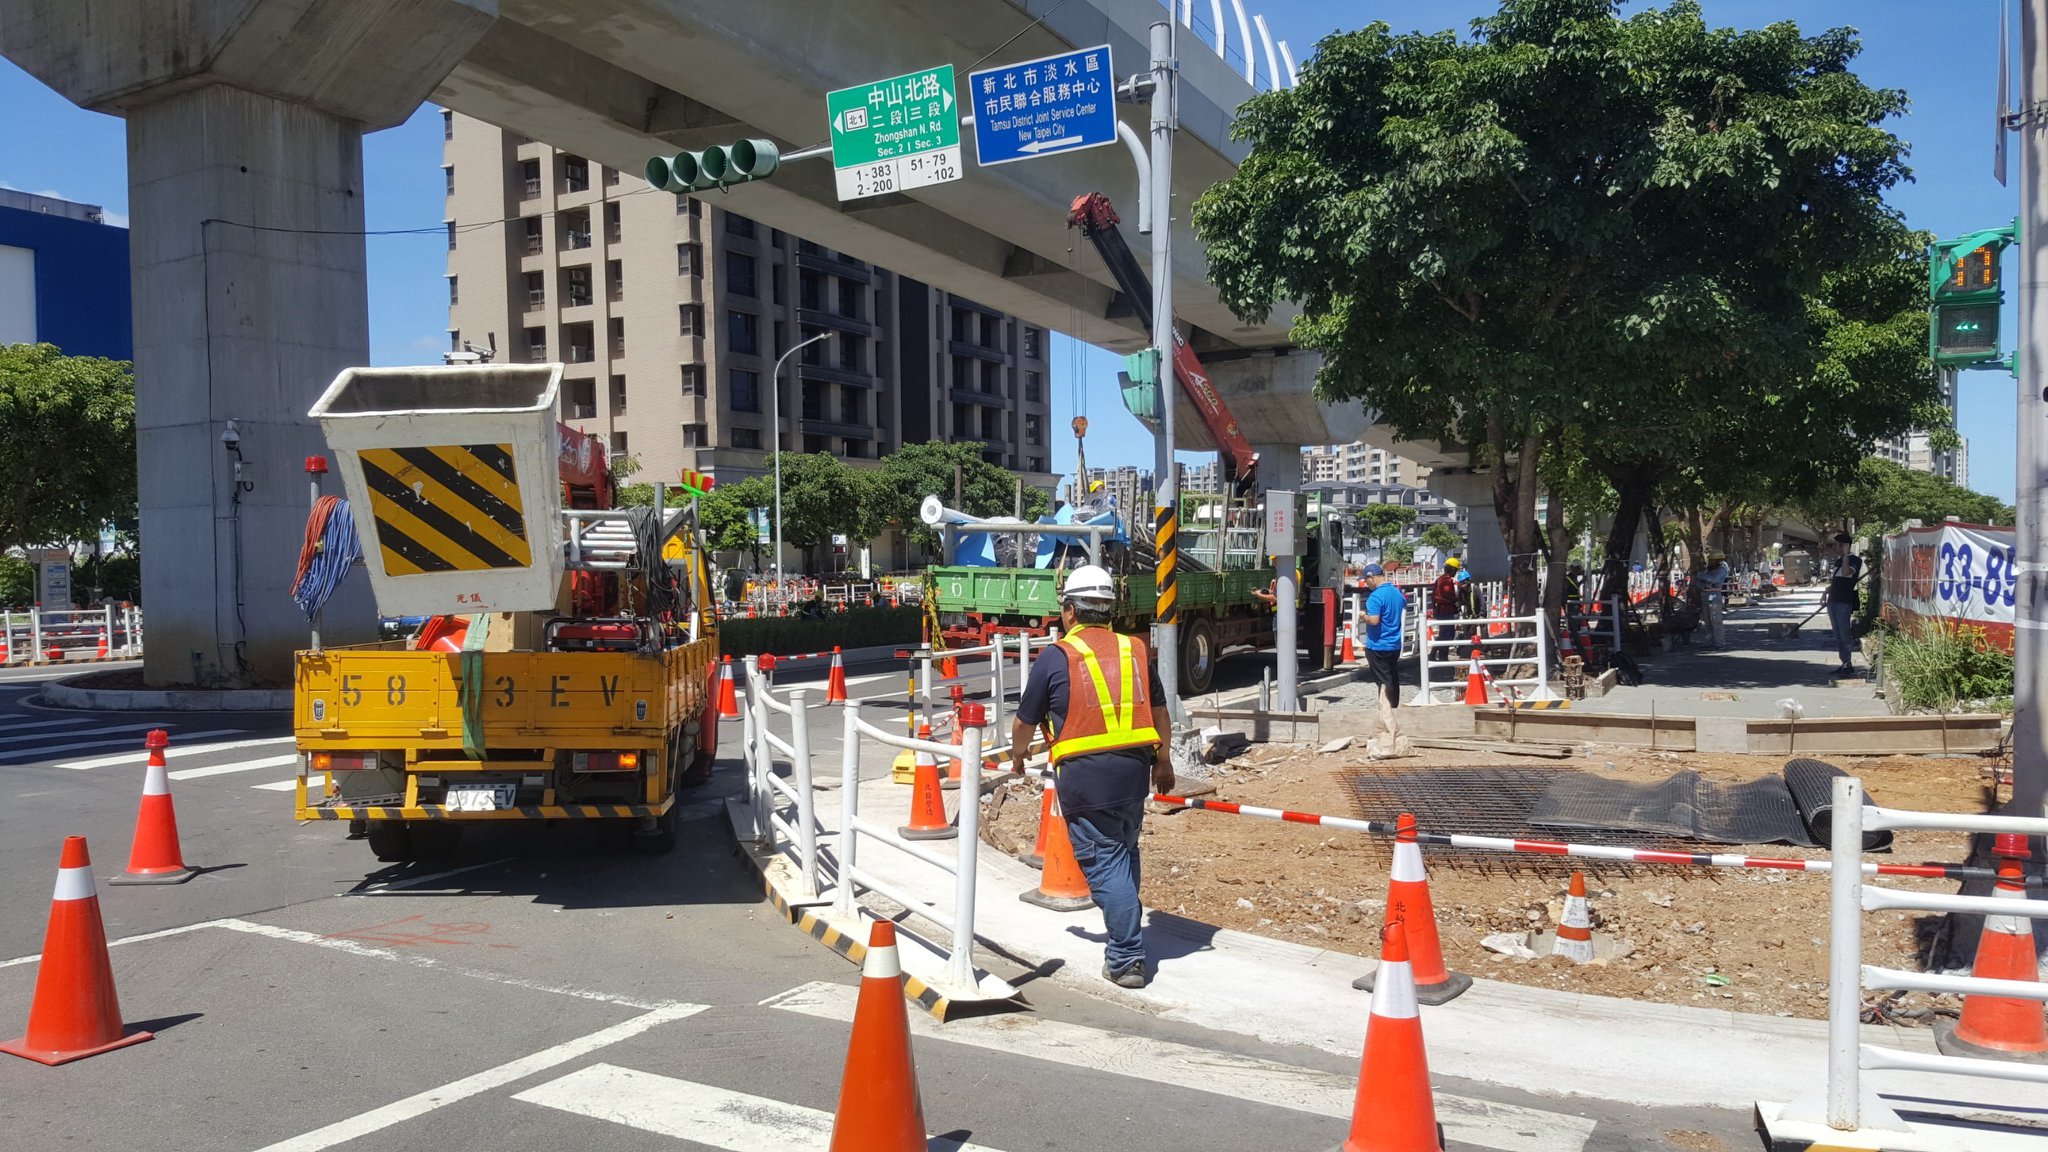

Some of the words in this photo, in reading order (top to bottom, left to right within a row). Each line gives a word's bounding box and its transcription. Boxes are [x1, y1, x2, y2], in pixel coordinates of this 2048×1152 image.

[982, 53, 1099, 95] 新北市淡水區
[868, 73, 940, 111] 中山北路
[985, 77, 1100, 116] 市民聯合服務中心
[990, 117, 1011, 132] Tamsui
[1013, 114, 1033, 128] District
[1035, 111, 1050, 124] Joint
[1051, 107, 1075, 121] Service
[1076, 103, 1097, 116] Center
[874, 127, 918, 145] Zhongshan
[919, 124, 928, 134] N.
[930, 120, 943, 132] Rd.
[877, 147, 896, 157] Sec.
[899, 143, 904, 153] 2
[915, 139, 934, 150] Sec.
[936, 135, 942, 145] 3
[1018, 129, 1032, 142] New
[1034, 125, 1052, 140] Taipei
[1052, 123, 1066, 137] City
